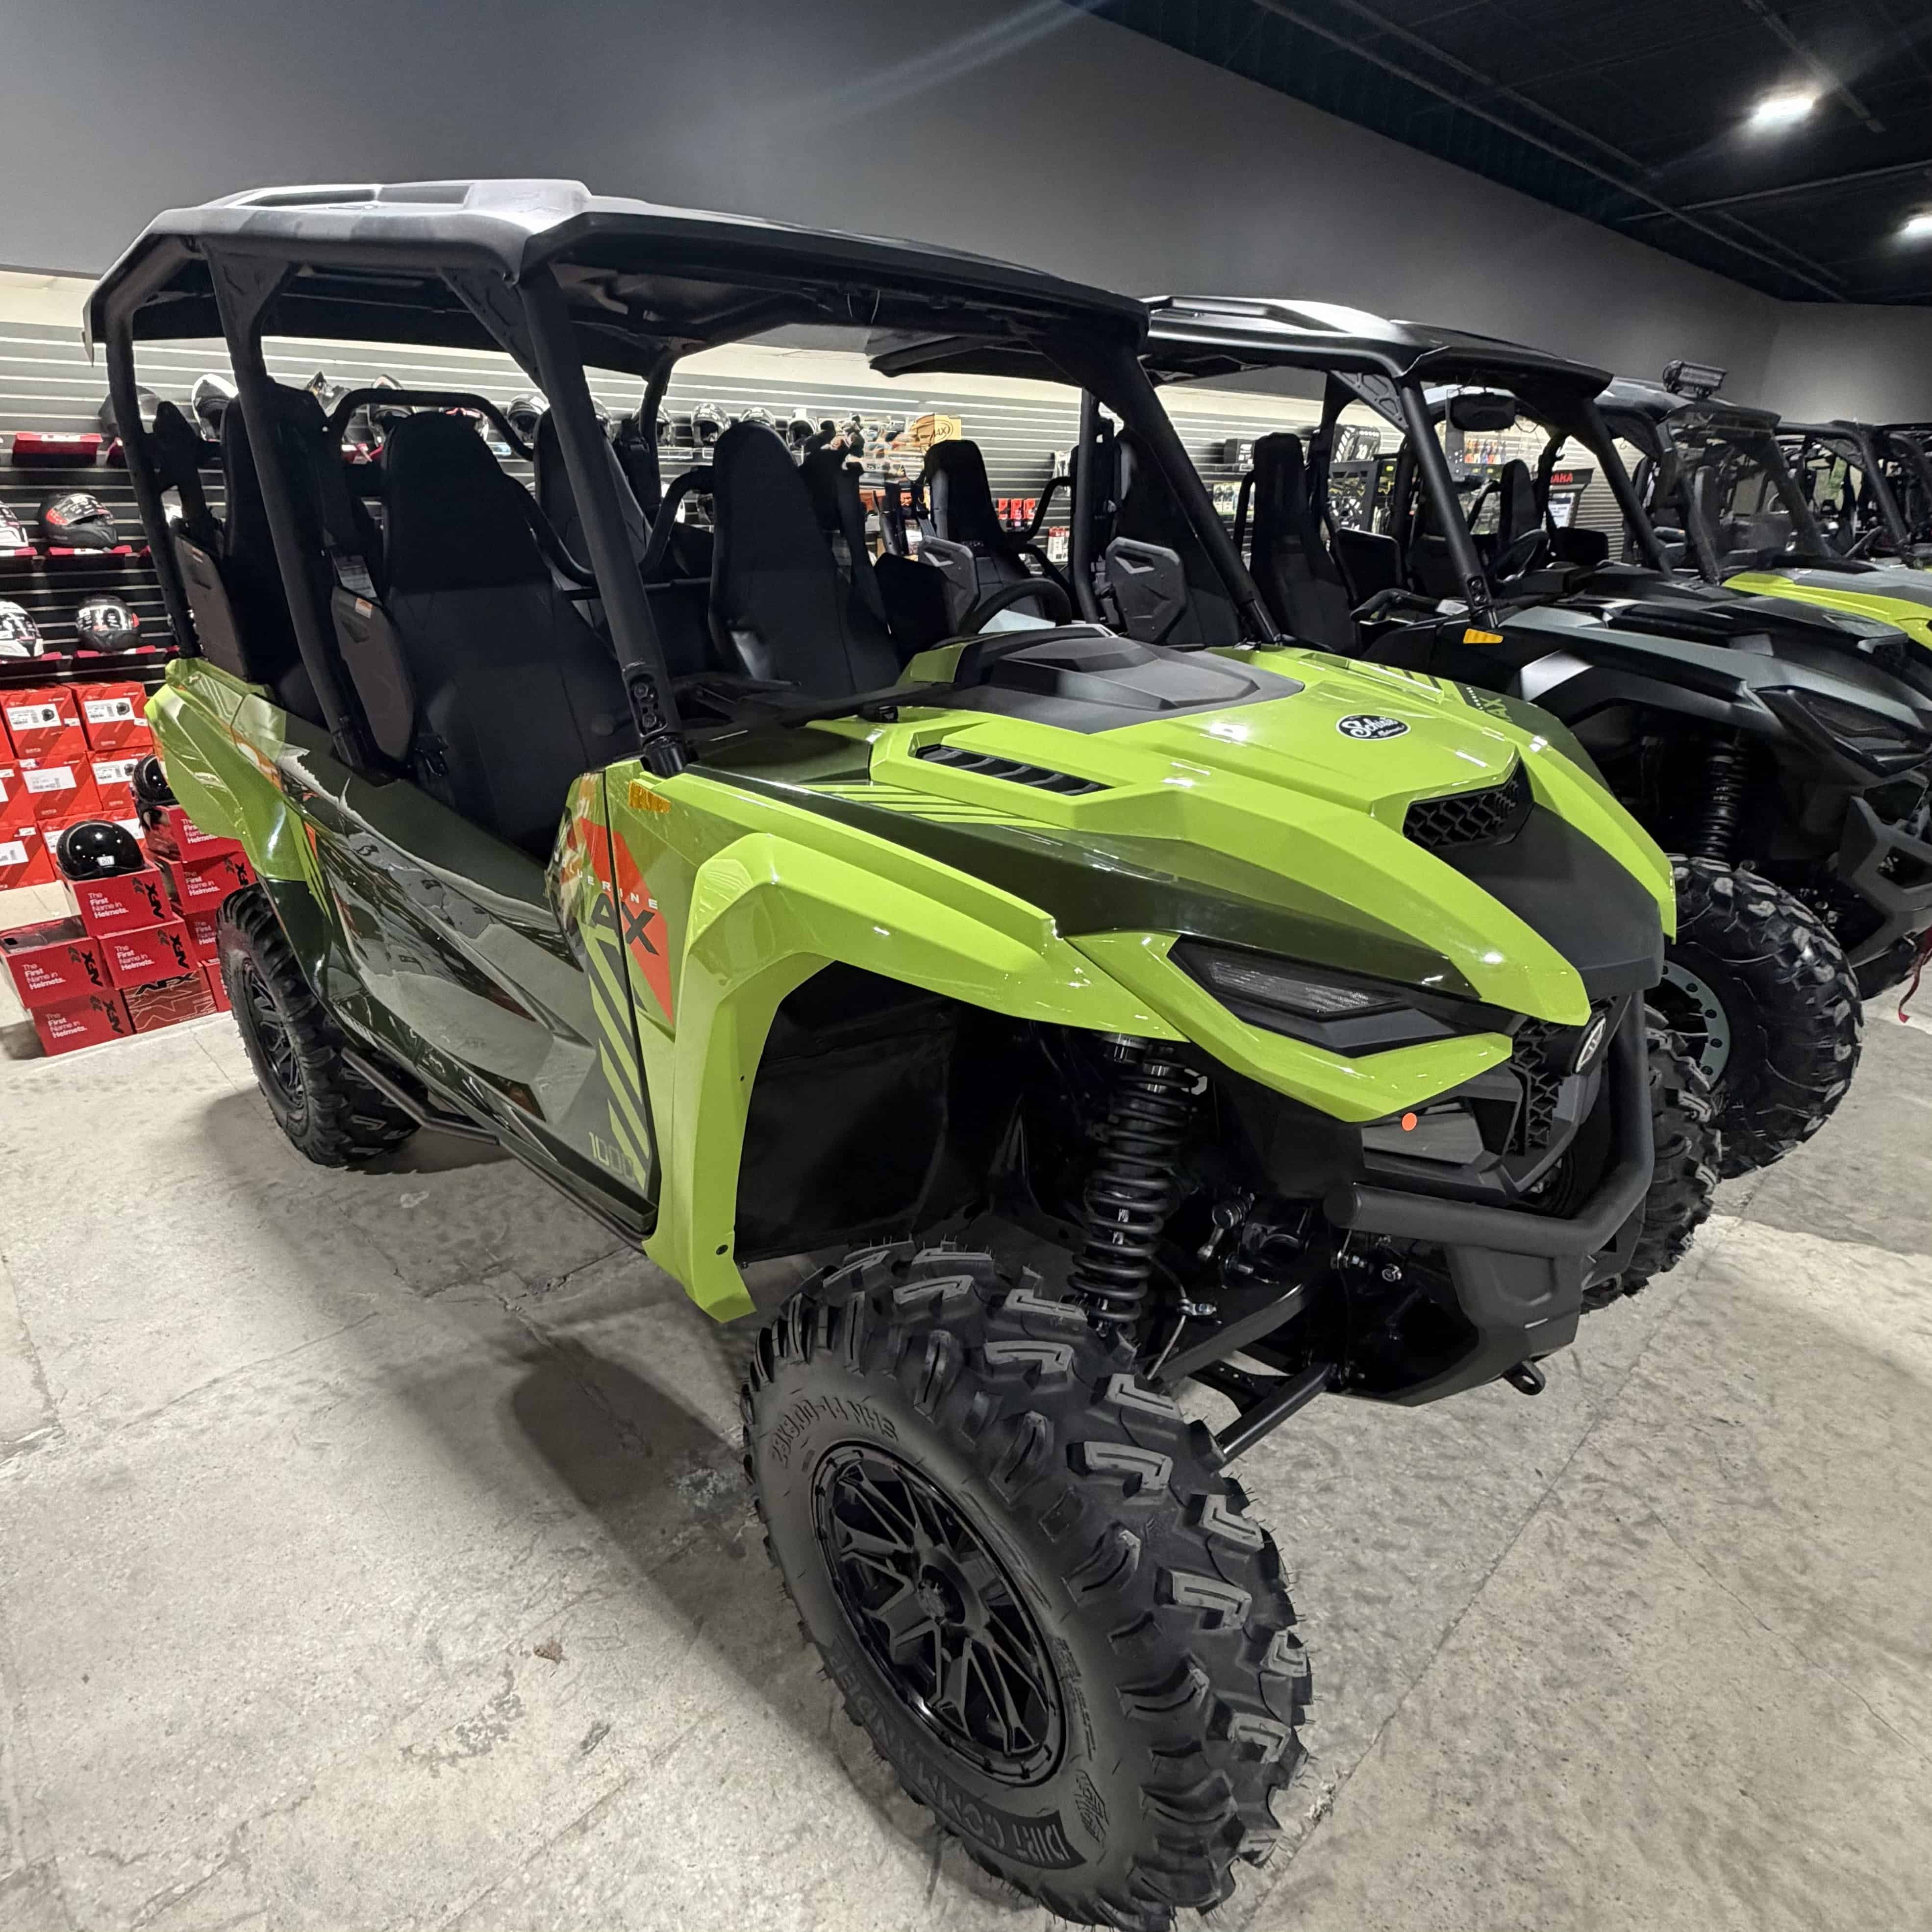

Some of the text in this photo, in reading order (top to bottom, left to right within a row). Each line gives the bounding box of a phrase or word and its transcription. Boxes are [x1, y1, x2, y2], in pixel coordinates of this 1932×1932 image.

[90, 897, 108, 906] First
[92, 903, 114, 912] Name
[94, 907, 129, 919] Helmets.
[116, 950, 135, 959] First
[119, 955, 141, 964] Name
[121, 959, 155, 971] Helmets.
[25, 967, 44, 977] First
[26, 974, 50, 983] Name
[28, 978, 66, 990] Helmets.
[48, 1017, 67, 1027] First
[50, 1023, 73, 1032] Name
[589, 1131, 636, 1183] 1000
[1011, 1822, 1071, 1861] DIRT
